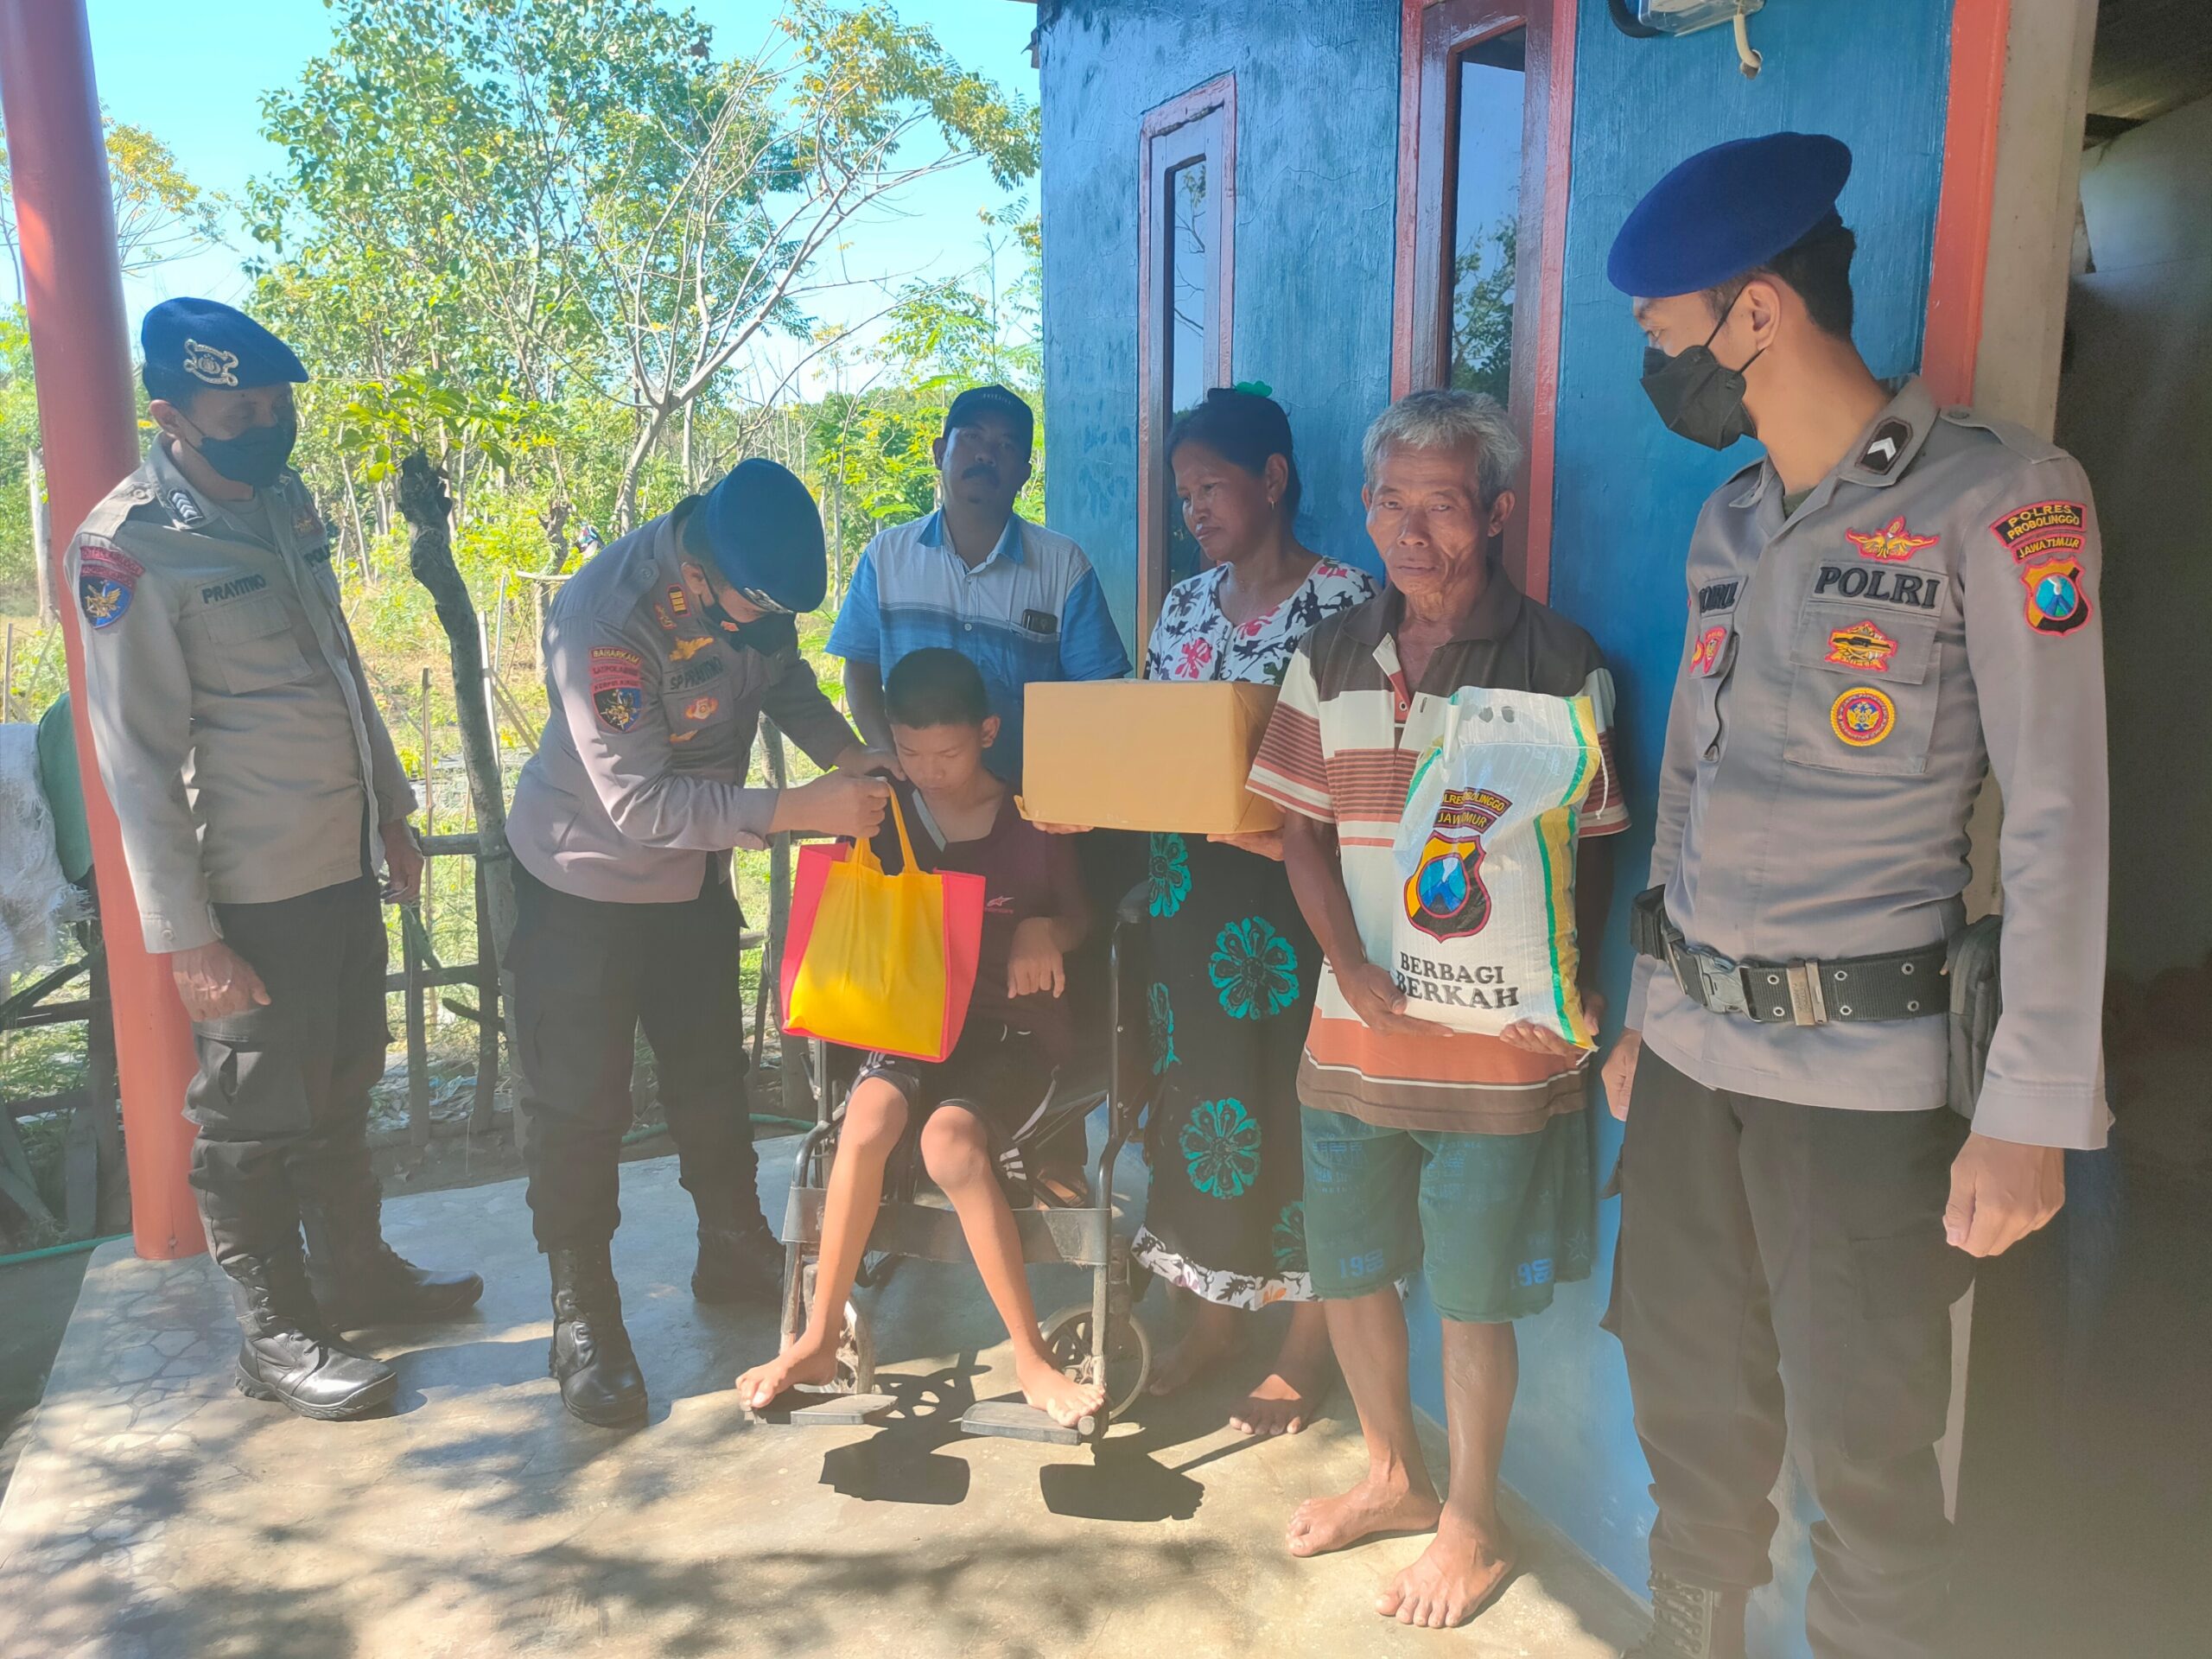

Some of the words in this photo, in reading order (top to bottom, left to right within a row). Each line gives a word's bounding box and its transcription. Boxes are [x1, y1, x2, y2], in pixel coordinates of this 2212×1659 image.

[2007, 515, 2080, 540] PROBOLINGGO
[2008, 505, 2072, 527] POLRES
[2018, 541, 2046, 558] JAWA
[2045, 537, 2080, 550] TIMUR
[1814, 566, 1941, 609] POLRI
[1400, 951, 1504, 983] BERBAGI
[1396, 969, 1520, 1009] BERKAH
